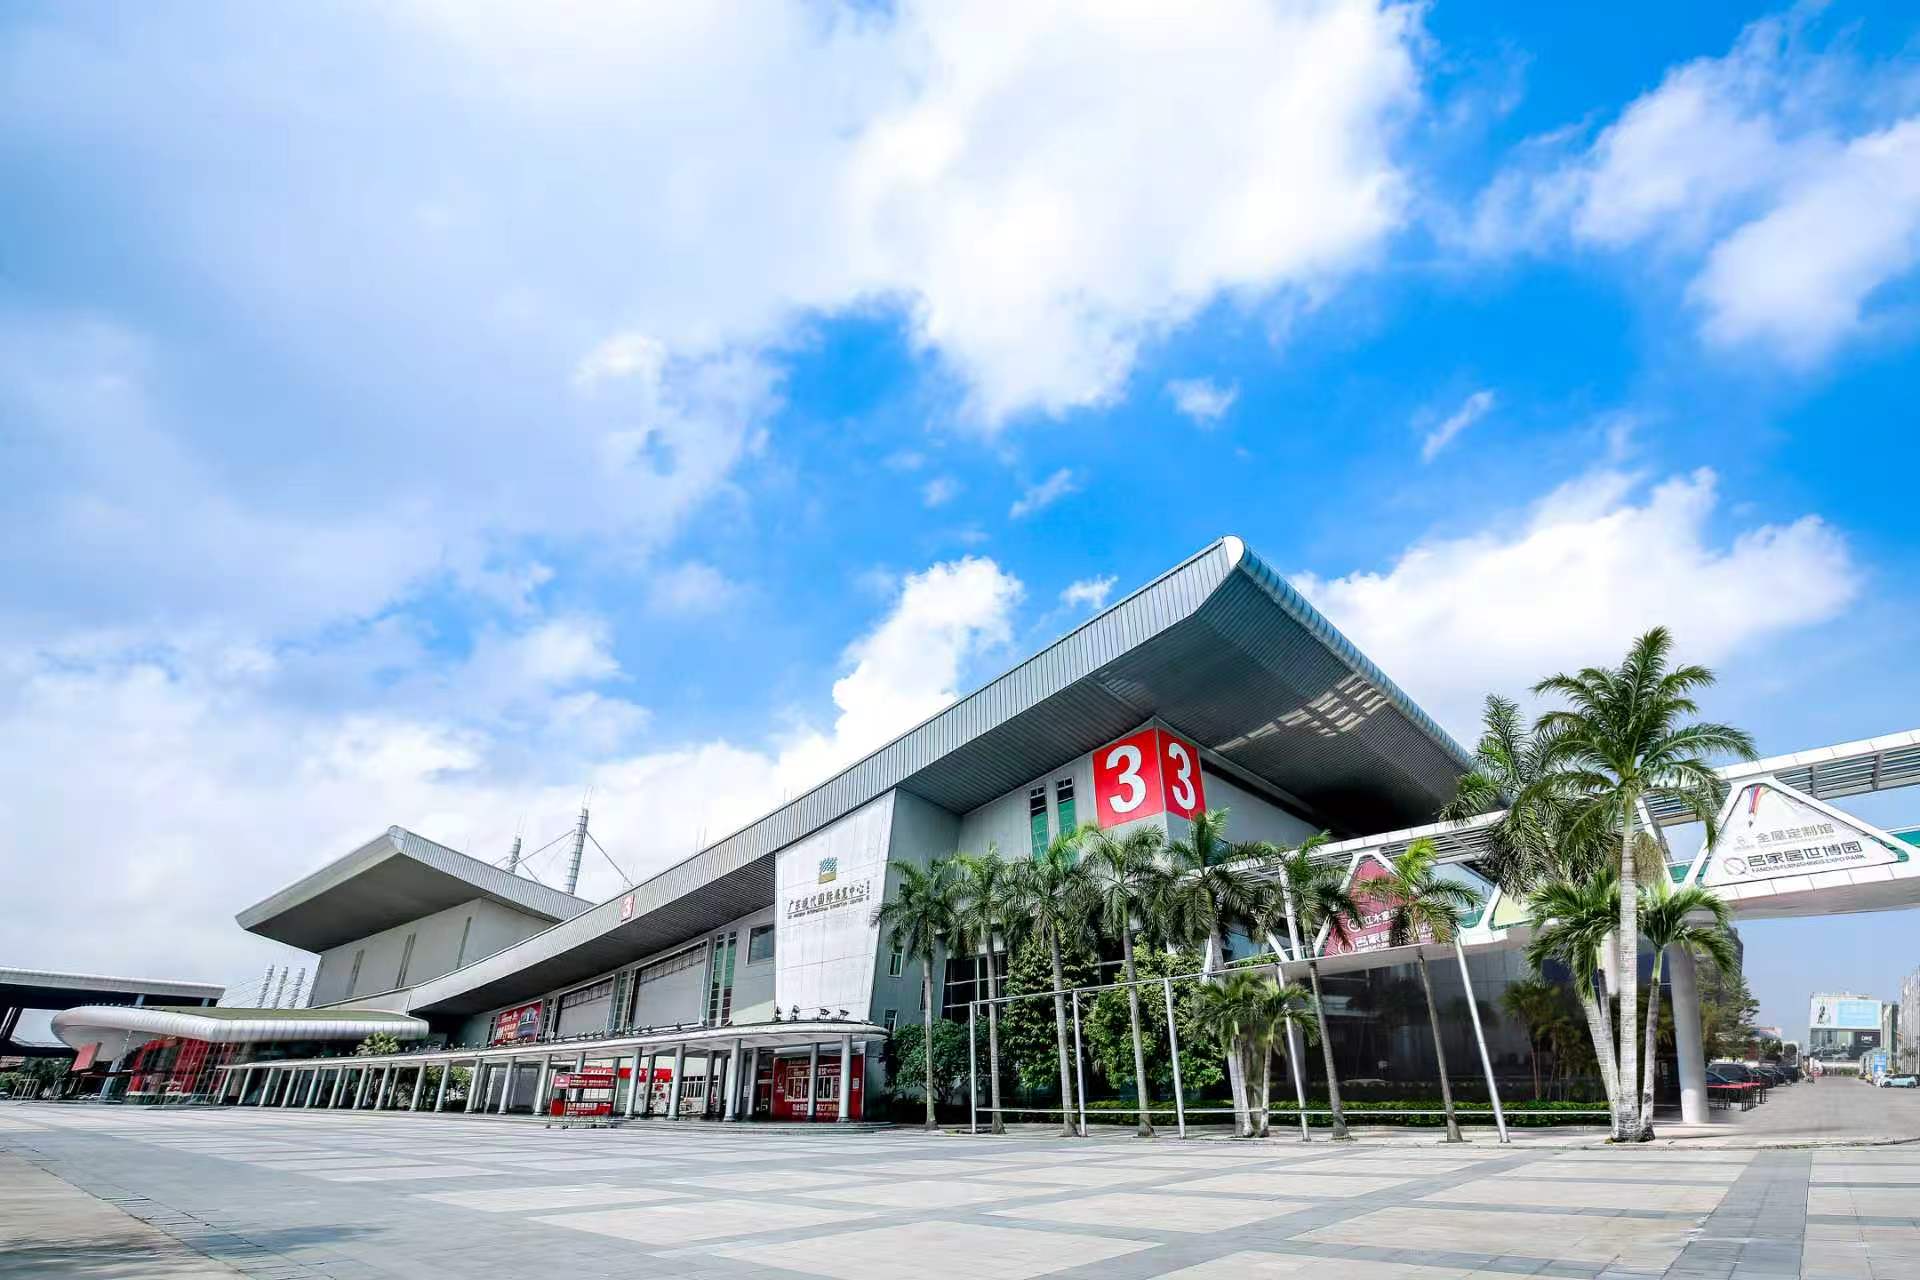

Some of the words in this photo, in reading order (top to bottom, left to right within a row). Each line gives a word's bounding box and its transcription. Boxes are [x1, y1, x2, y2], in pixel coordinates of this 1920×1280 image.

[1106, 745, 1147, 813] 3
[1168, 742, 1196, 810] 3
[1756, 822, 1835, 843] 全屋定制馆
[1748, 840, 1863, 867] 名家居世博园
[1846, 853, 1866, 863] PARK
